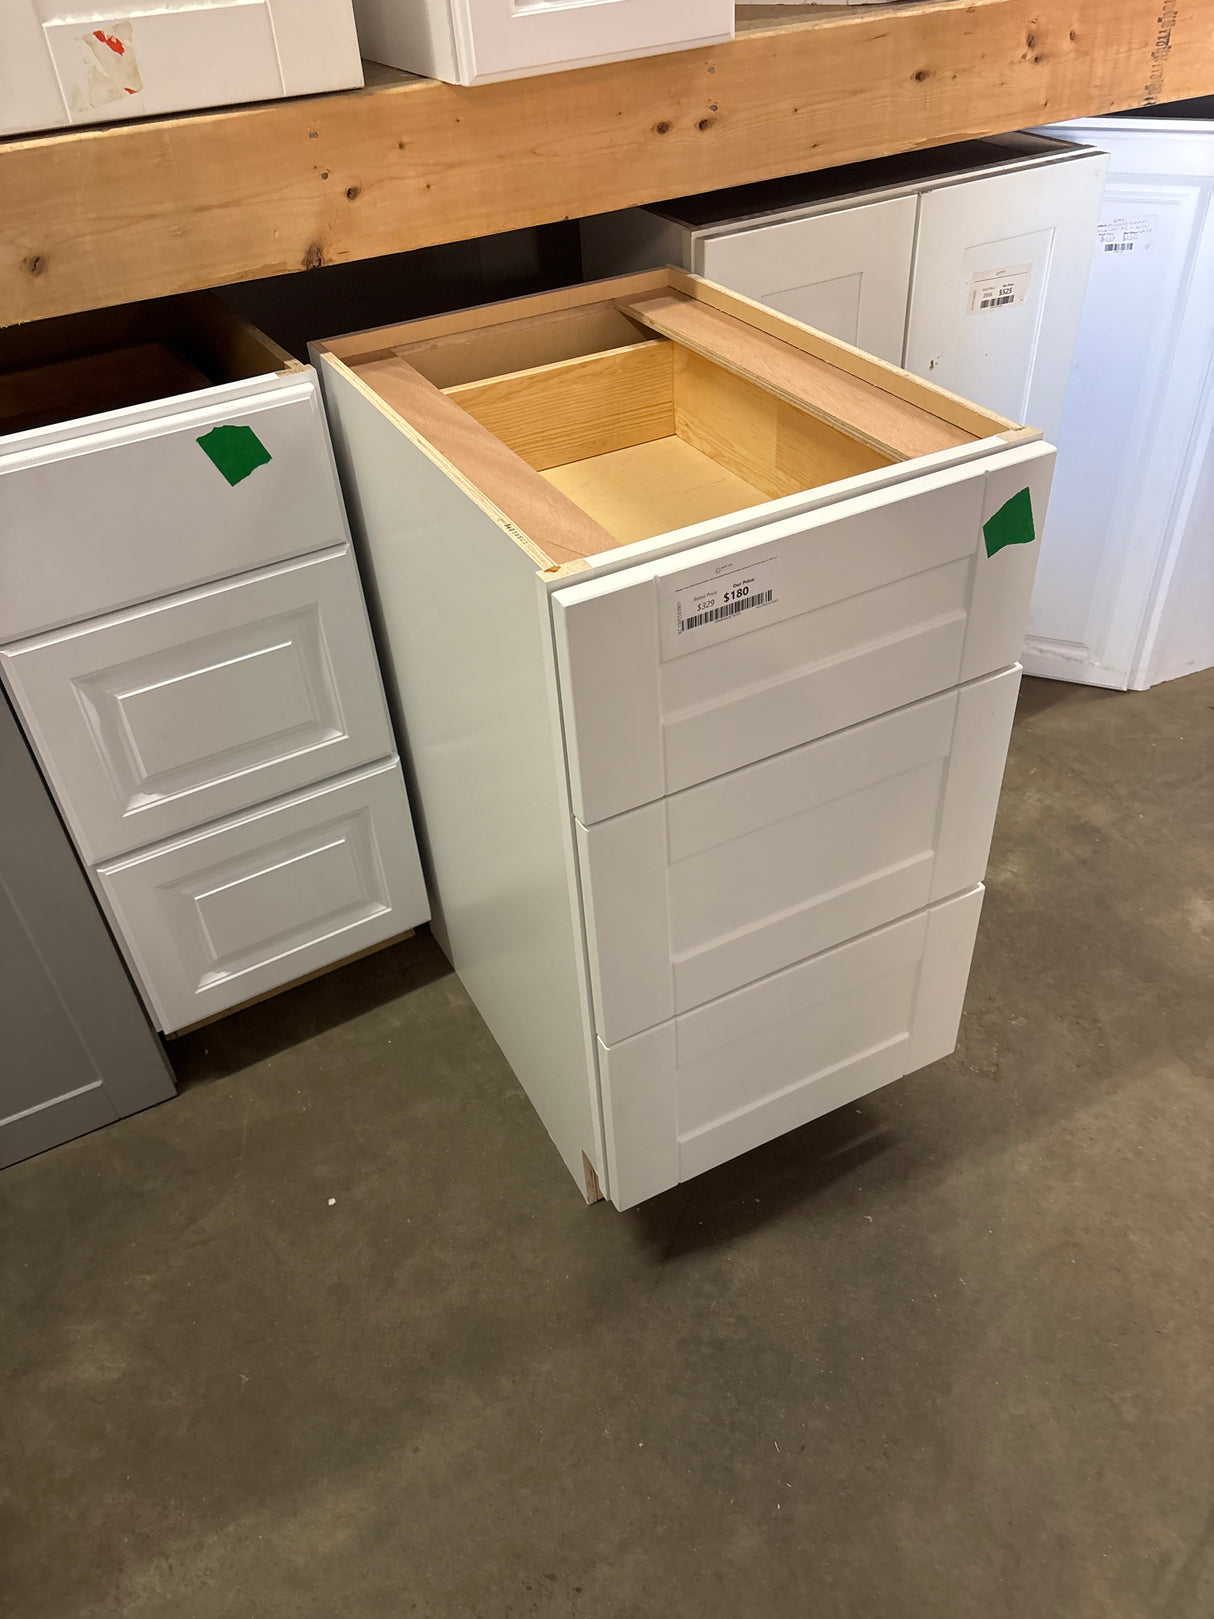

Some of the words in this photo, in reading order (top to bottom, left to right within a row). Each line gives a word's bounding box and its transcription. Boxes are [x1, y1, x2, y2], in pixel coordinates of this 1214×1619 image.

[732, 581, 742, 589] Our
[723, 586, 749, 603] $180
[697, 599, 715, 612] $329
